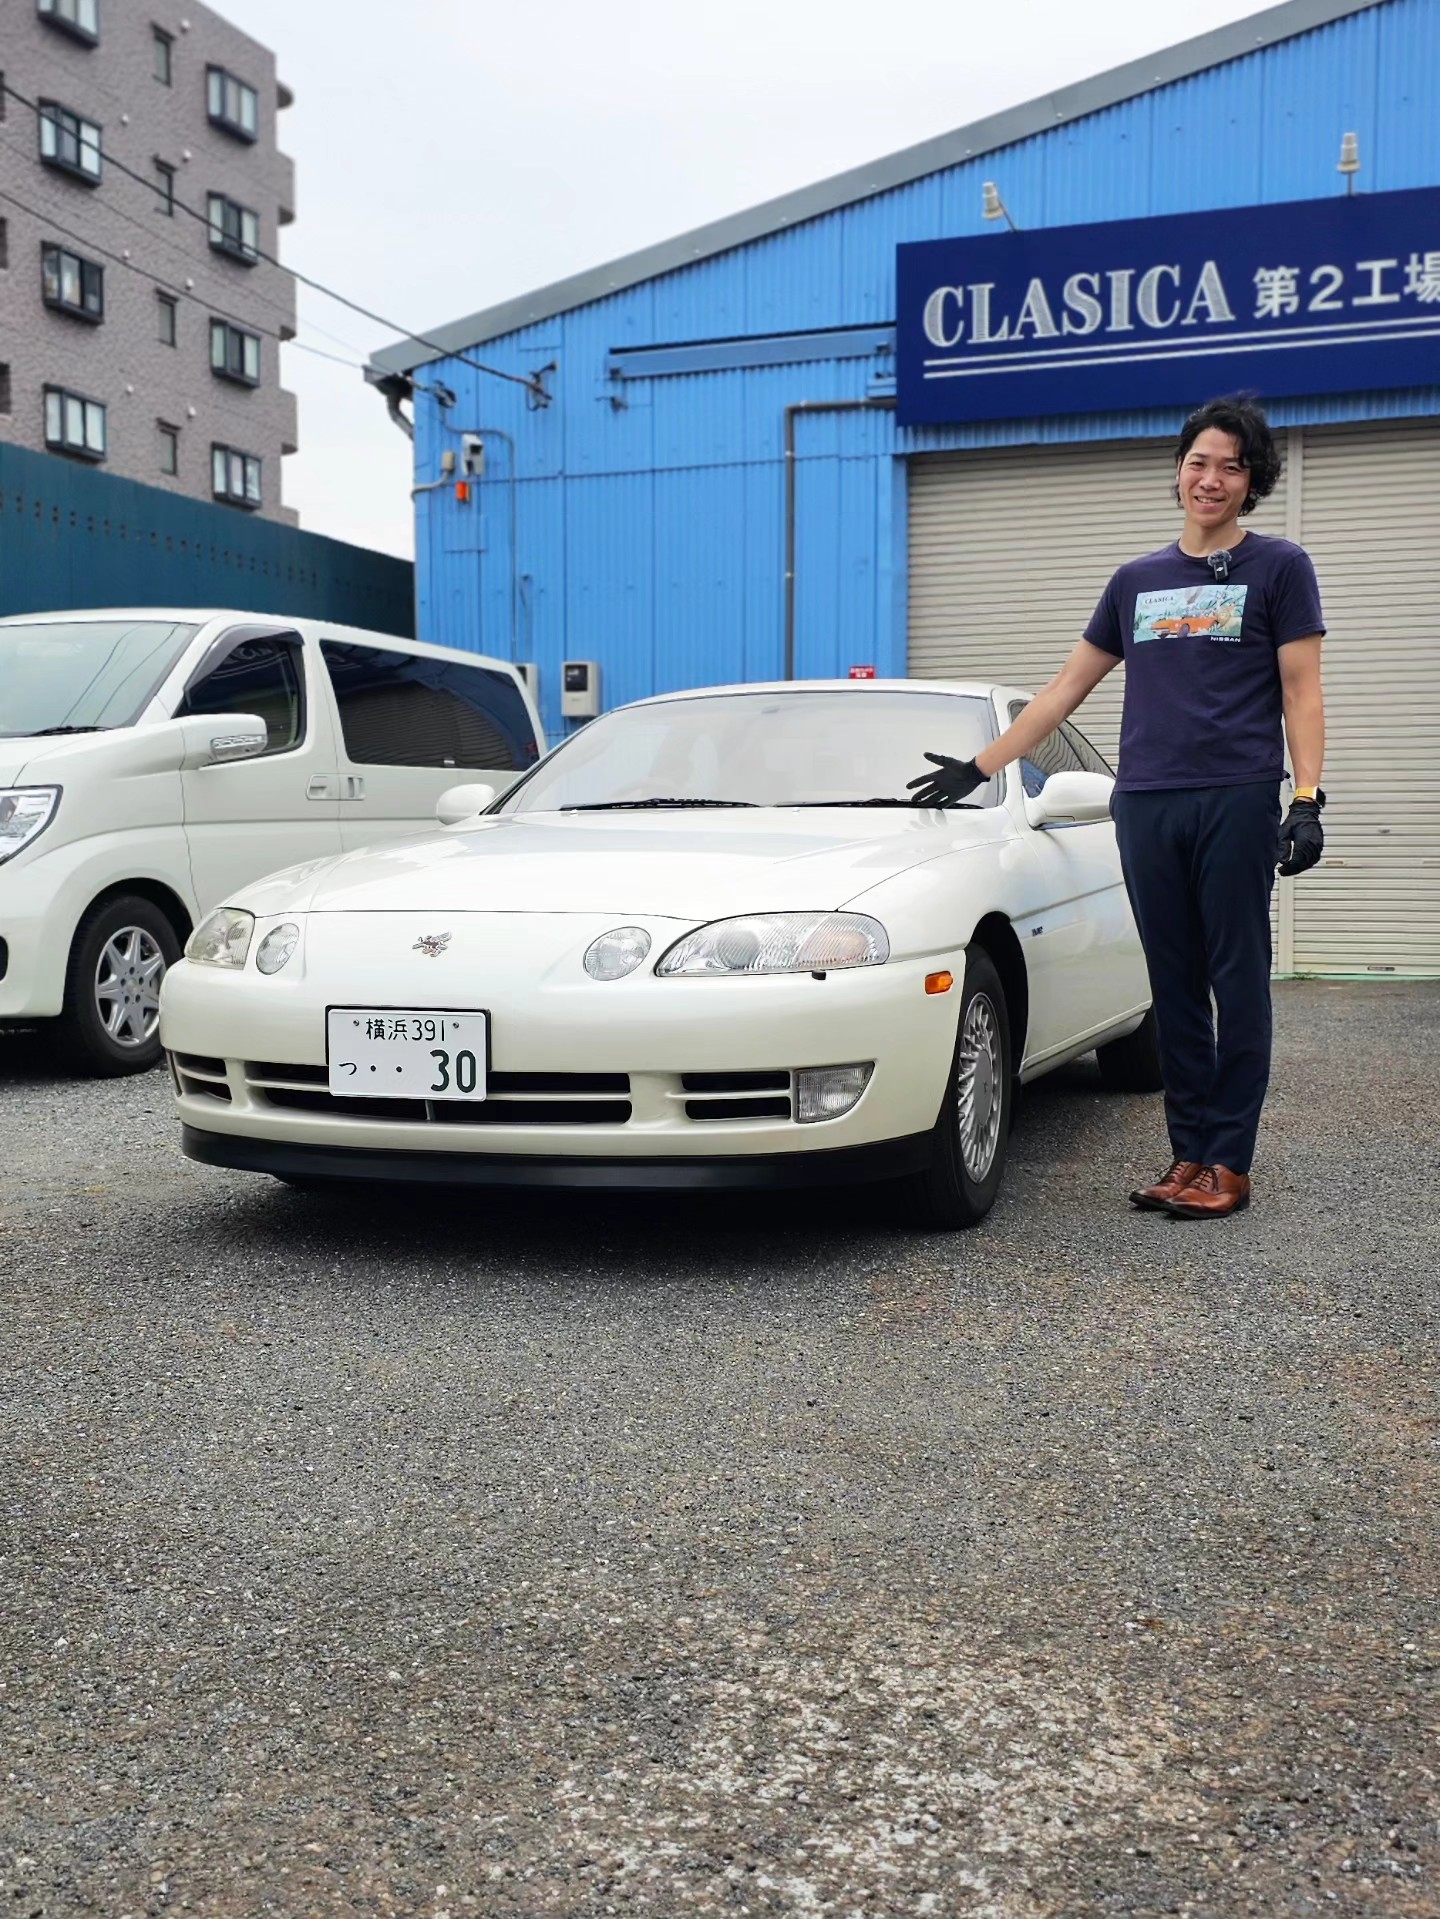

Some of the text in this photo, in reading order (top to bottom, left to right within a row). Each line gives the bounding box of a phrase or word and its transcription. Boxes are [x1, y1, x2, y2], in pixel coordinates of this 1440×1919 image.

[922, 252, 1440, 347] CLASICA 第2工場
